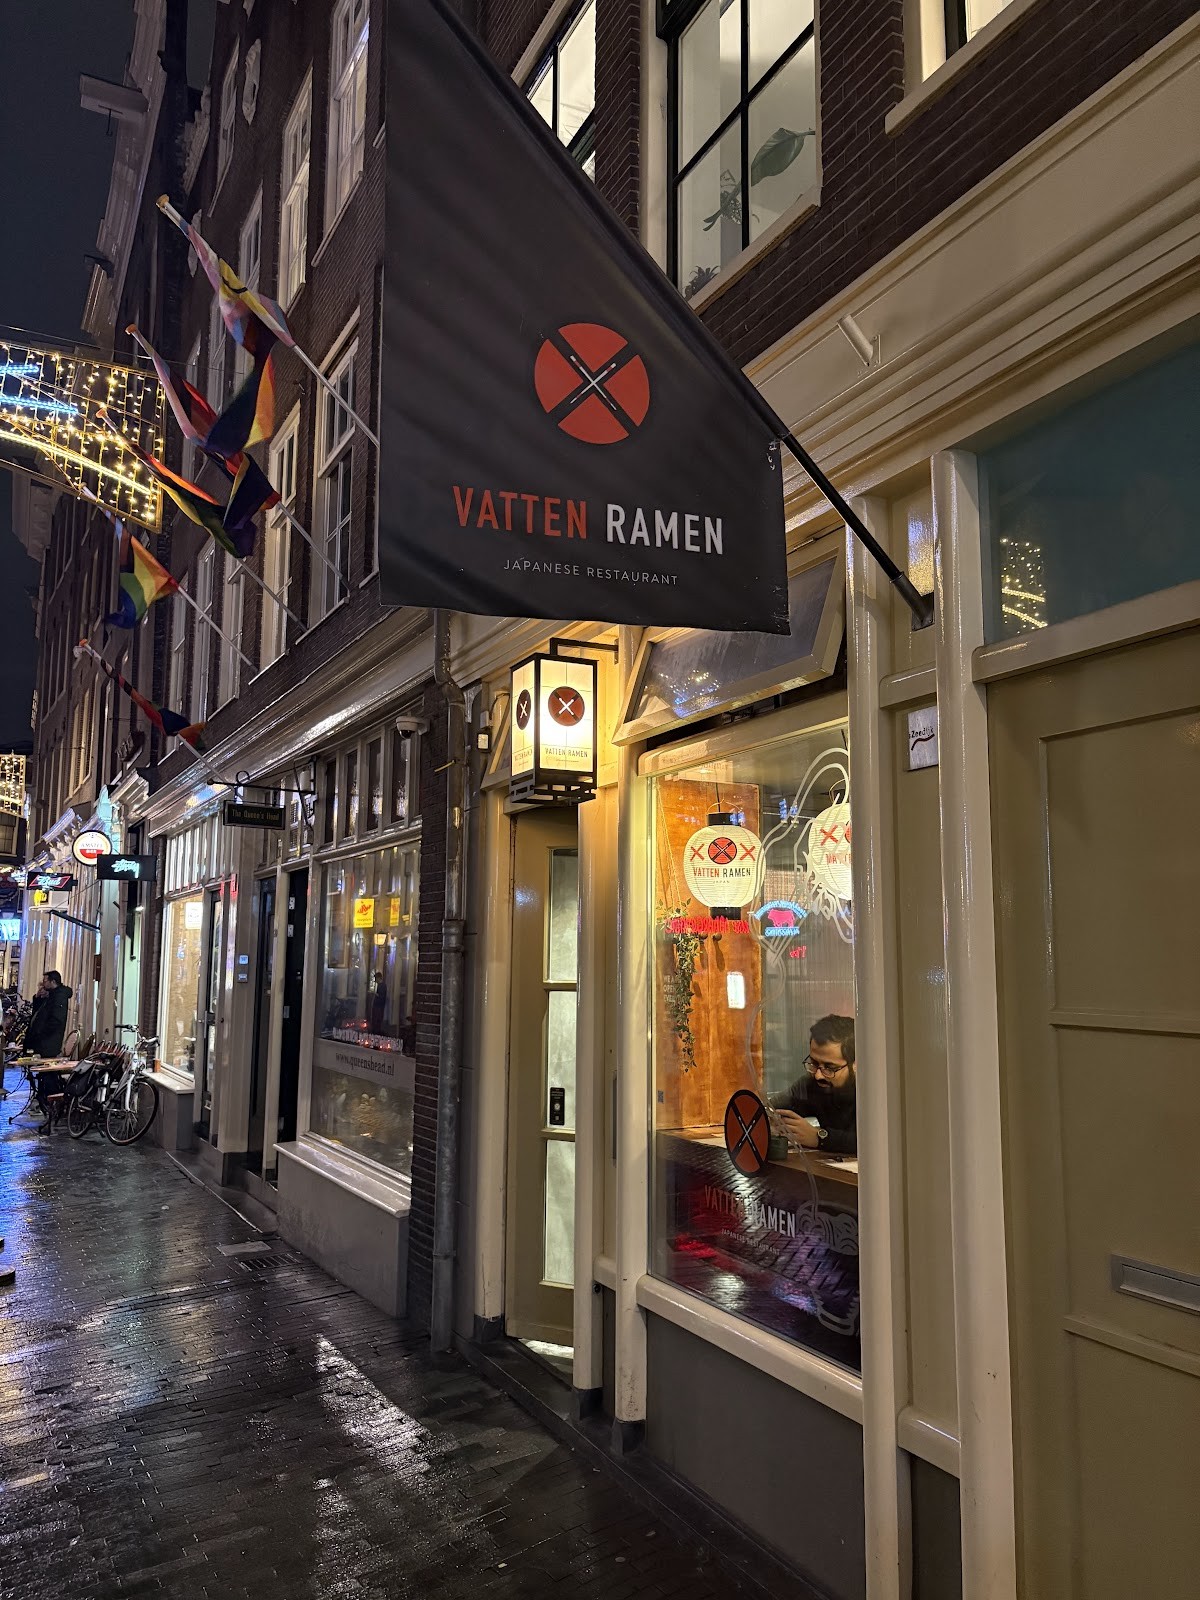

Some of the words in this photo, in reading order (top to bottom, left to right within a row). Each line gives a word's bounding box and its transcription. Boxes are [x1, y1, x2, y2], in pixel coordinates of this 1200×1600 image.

[452, 485, 588, 540] VATTEN
[606, 503, 724, 556] RAMEN
[503, 558, 580, 577] JAPANESE
[587, 567, 679, 586] RESTAURANT
[544, 747, 566, 756] VATTEN
[568, 750, 588, 758] RAMEN
[693, 867, 720, 878] VATTEN
[722, 867, 751, 878] RAMEN
[335, 1053, 394, 1075] www.queenshead.nl
[706, 1184, 744, 1218] VATTEN
[752, 1201, 795, 1238] RAMEN
